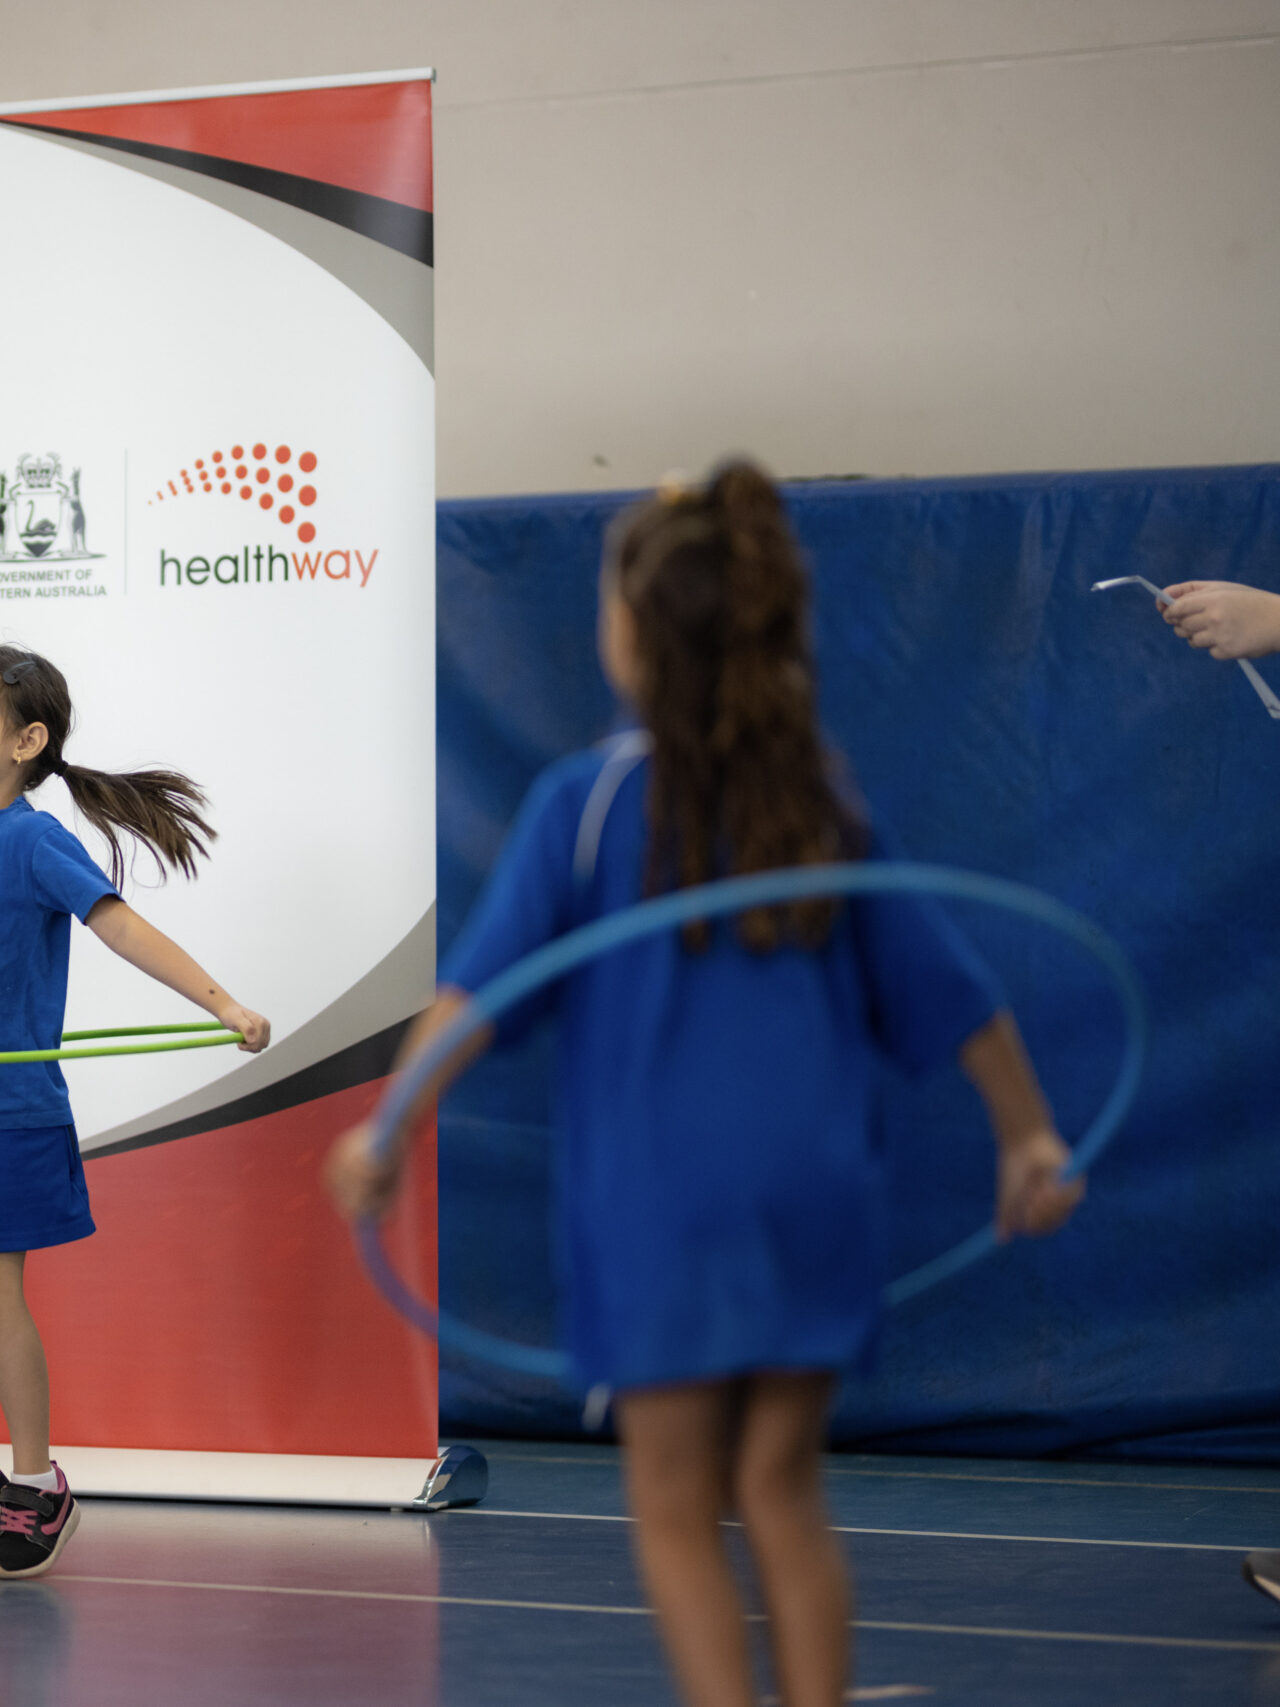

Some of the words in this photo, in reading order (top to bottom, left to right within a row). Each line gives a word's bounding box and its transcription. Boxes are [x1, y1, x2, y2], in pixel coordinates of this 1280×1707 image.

[160, 545, 379, 588] healthway
[75, 569, 93, 580] OF
[34, 585, 107, 598] AUSTRALIA
